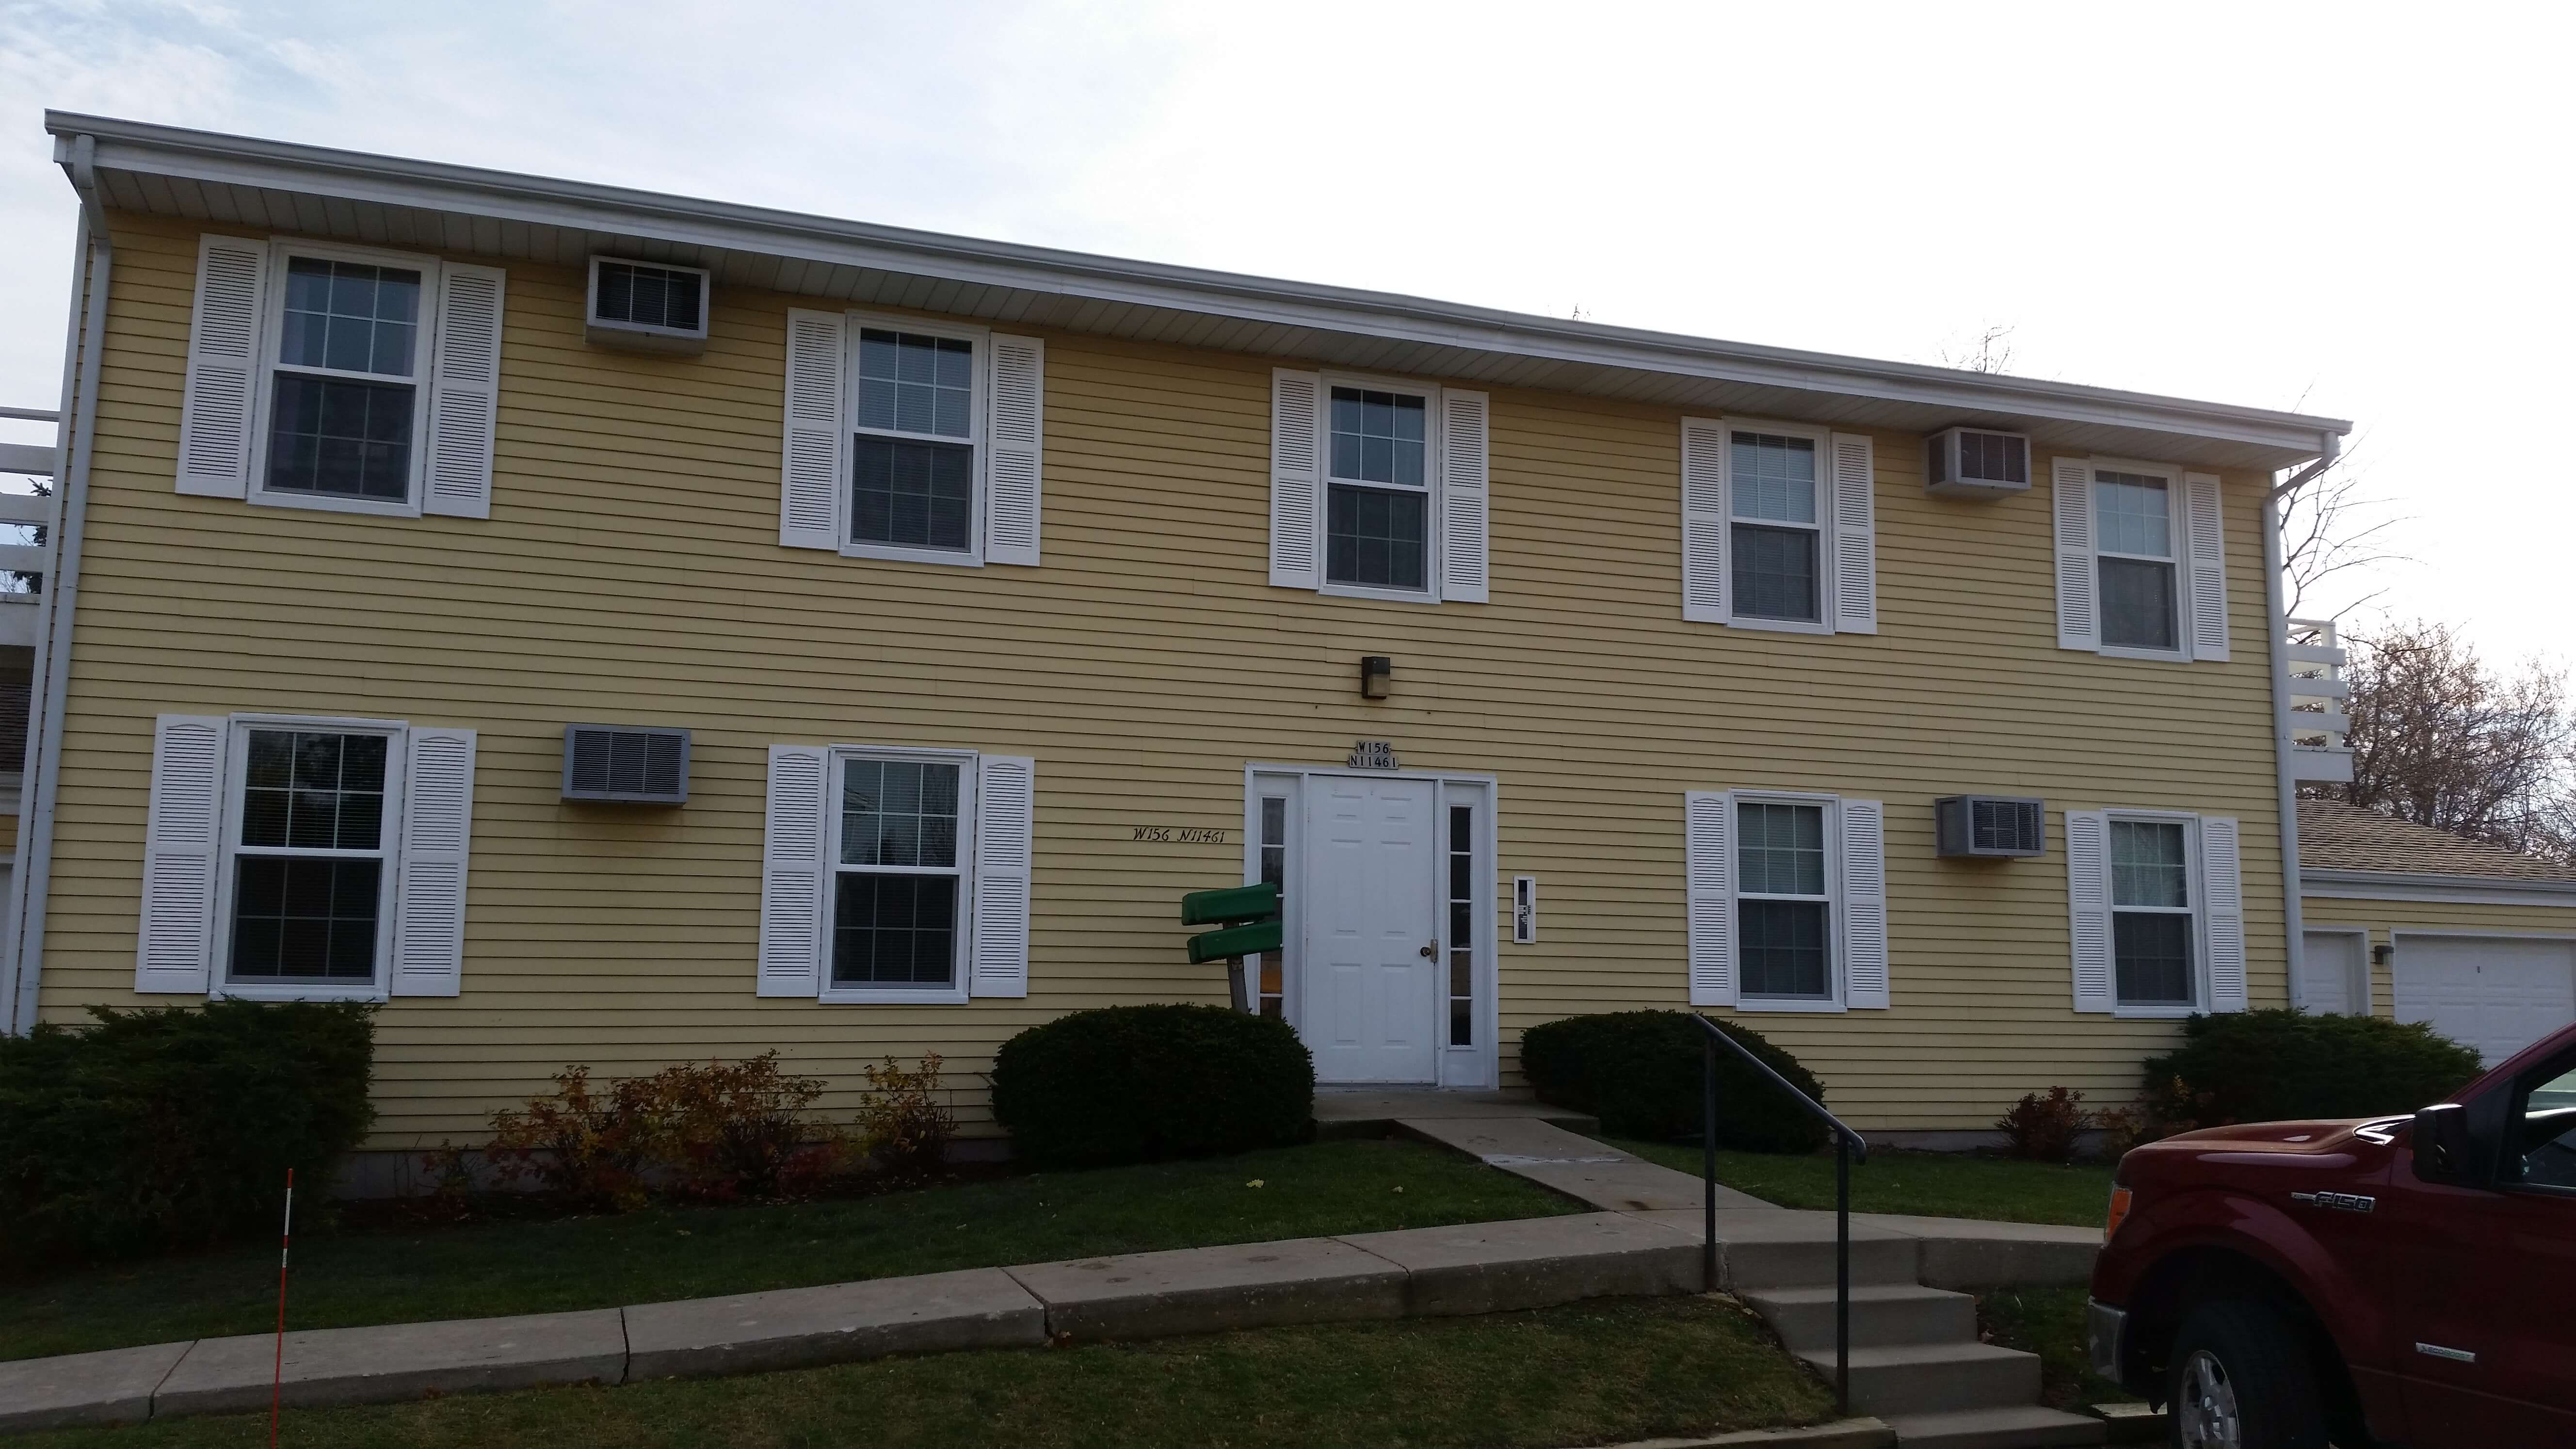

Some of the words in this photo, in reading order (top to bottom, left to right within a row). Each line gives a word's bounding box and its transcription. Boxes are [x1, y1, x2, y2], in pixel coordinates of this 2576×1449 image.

[1358, 741, 1389, 754] W156
[1351, 756, 1395, 768] N11461
[1133, 827, 1170, 841] W156
[1177, 829, 1225, 843] N11461
